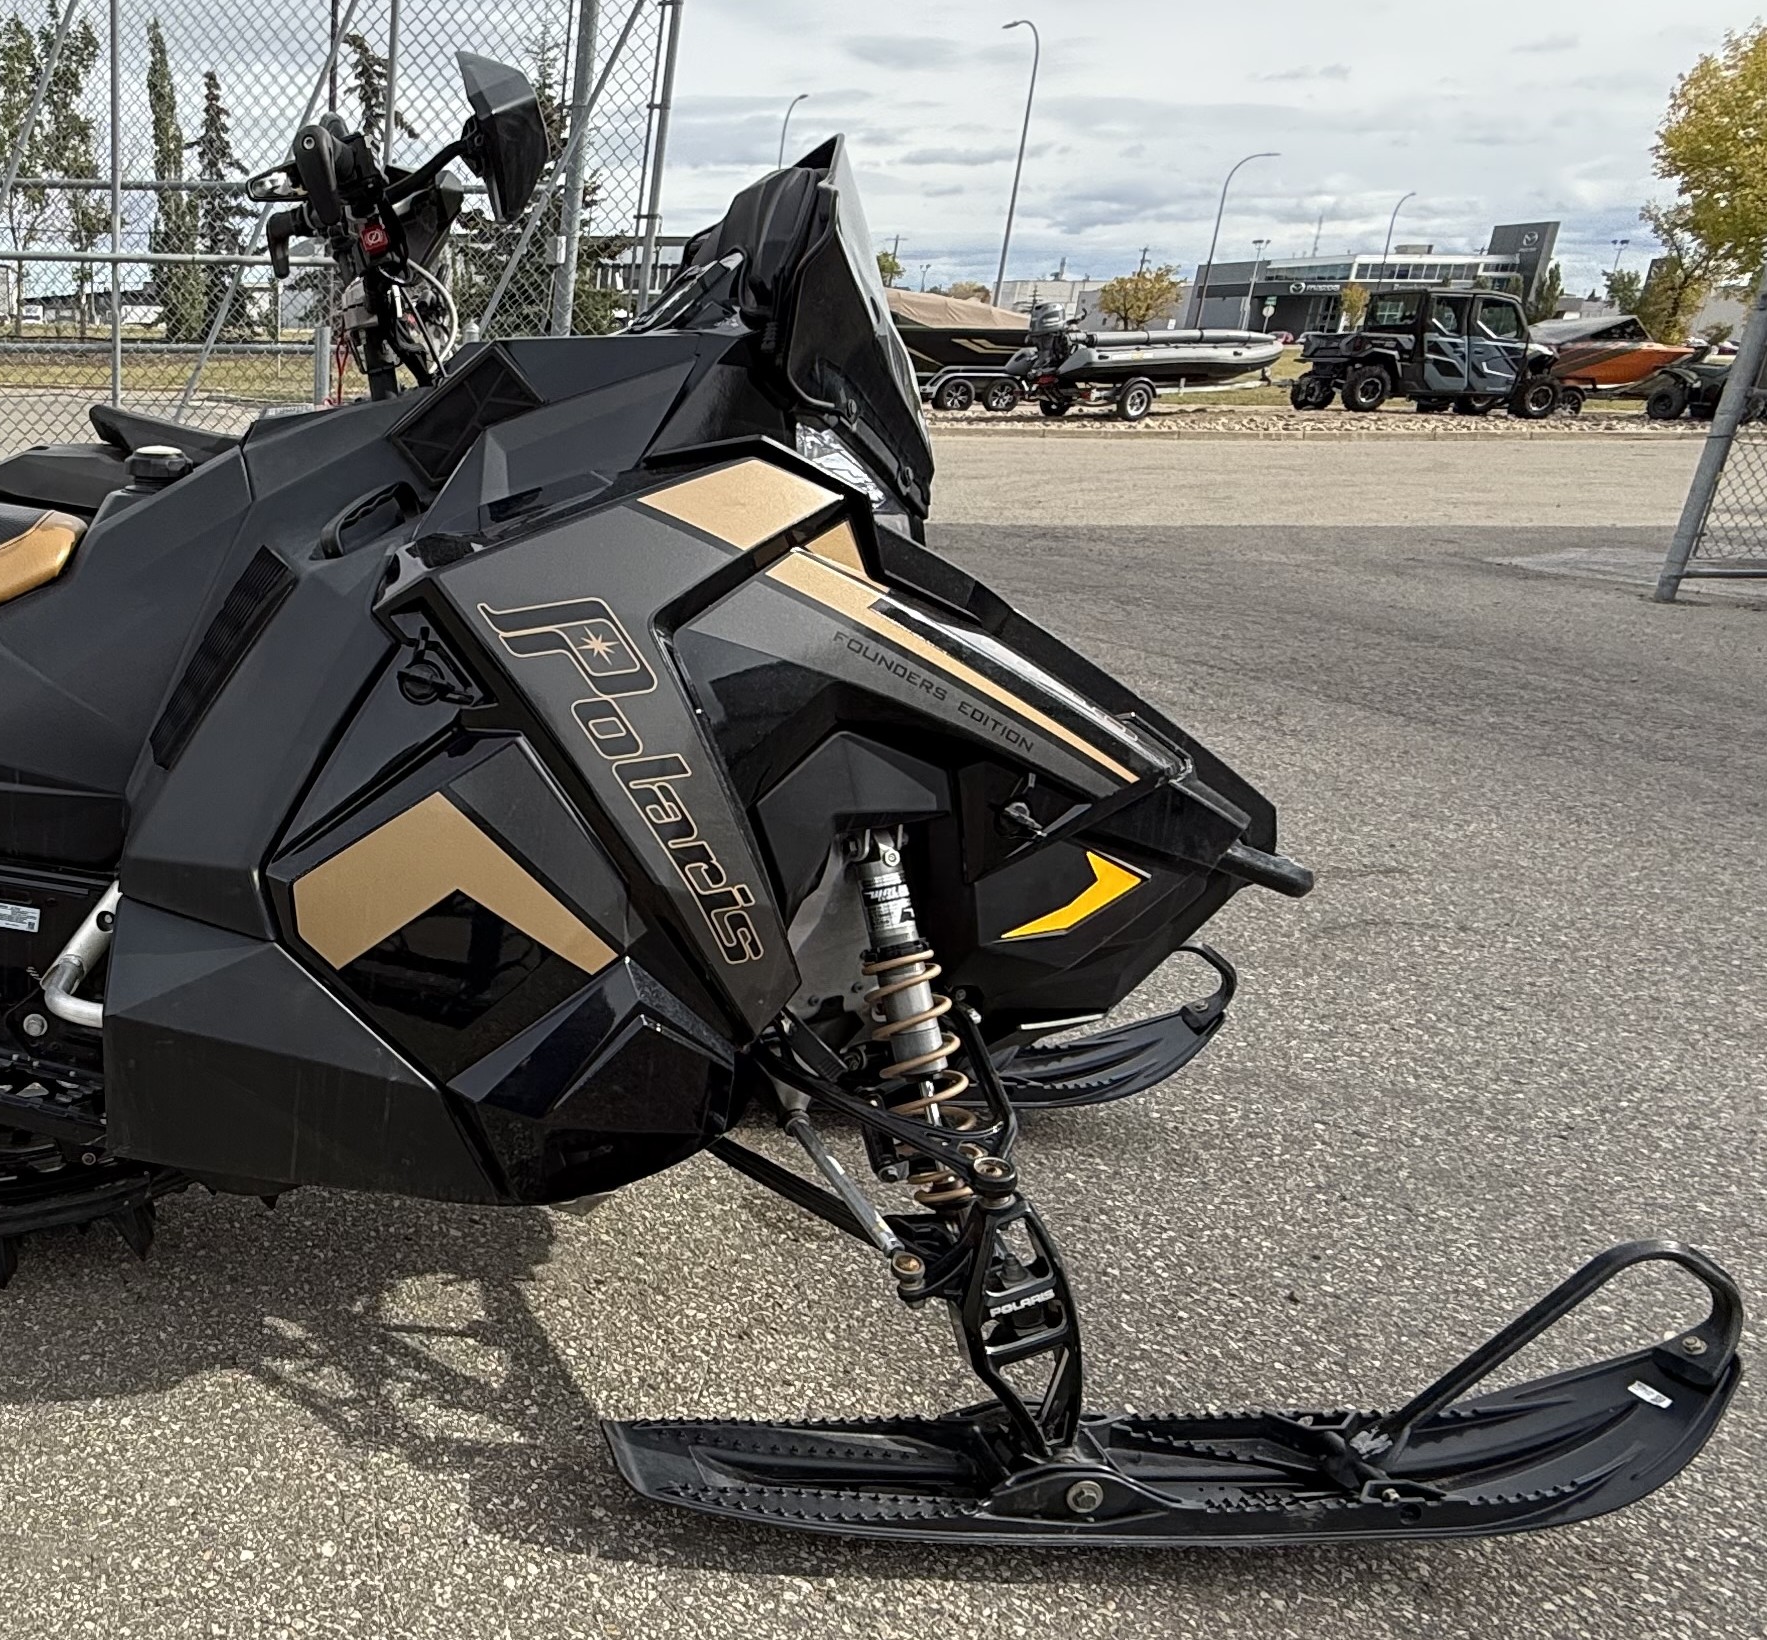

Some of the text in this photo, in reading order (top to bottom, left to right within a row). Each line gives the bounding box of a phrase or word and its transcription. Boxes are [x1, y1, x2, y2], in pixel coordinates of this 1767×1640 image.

[833, 631, 948, 701] FOUNDERS
[957, 701, 1034, 752] EDITION
[477, 597, 764, 964] Polaris
[989, 1288, 1056, 1318] POLARIS
